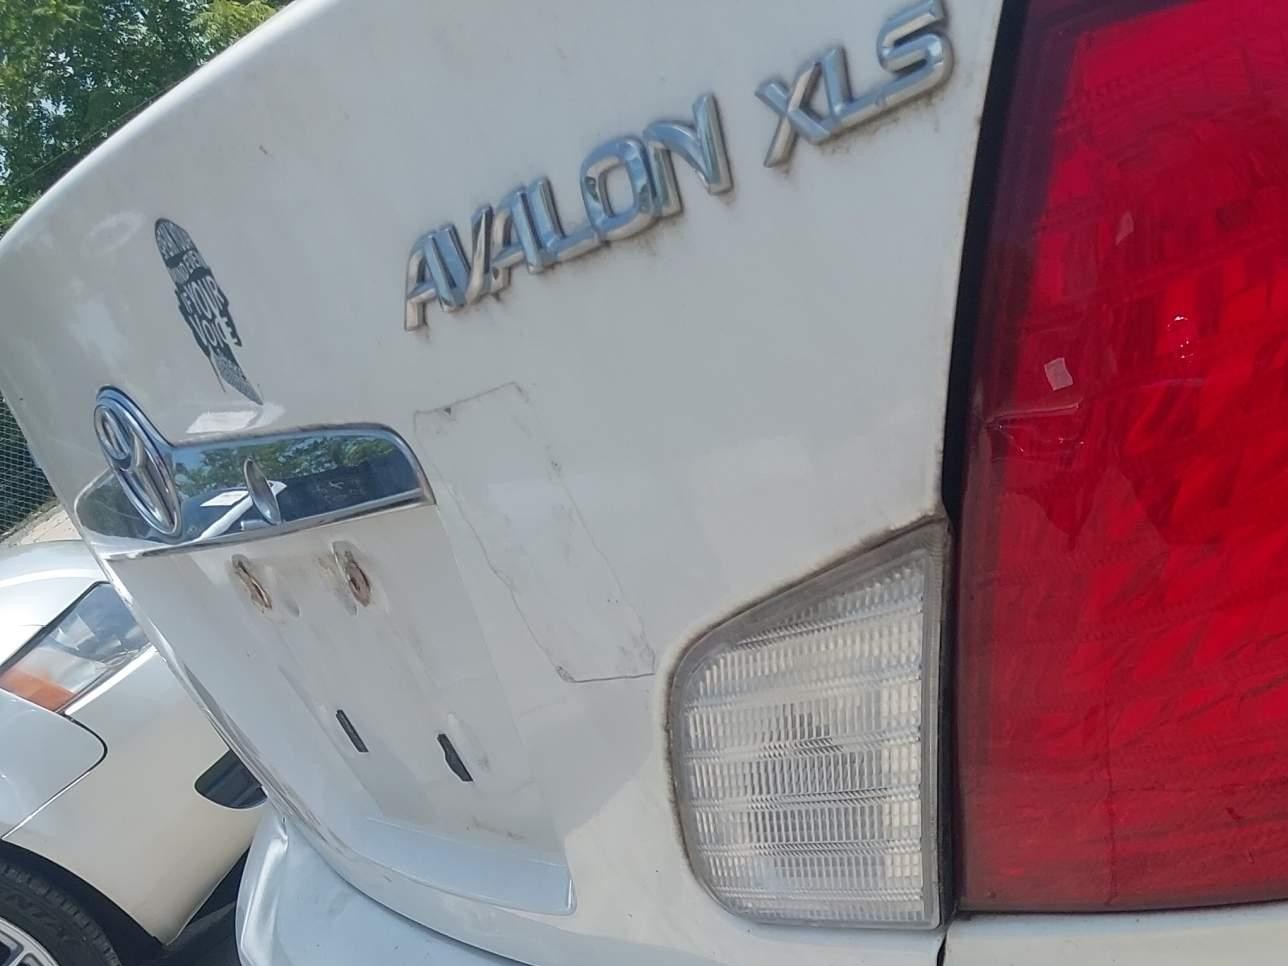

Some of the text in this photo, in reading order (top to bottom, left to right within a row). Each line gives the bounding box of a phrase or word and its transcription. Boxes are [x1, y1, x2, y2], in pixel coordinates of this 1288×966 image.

[404, 0, 954, 331] AVALON XLS
[183, 275, 225, 320] YOUR
[188, 313, 238, 348] VOICE
